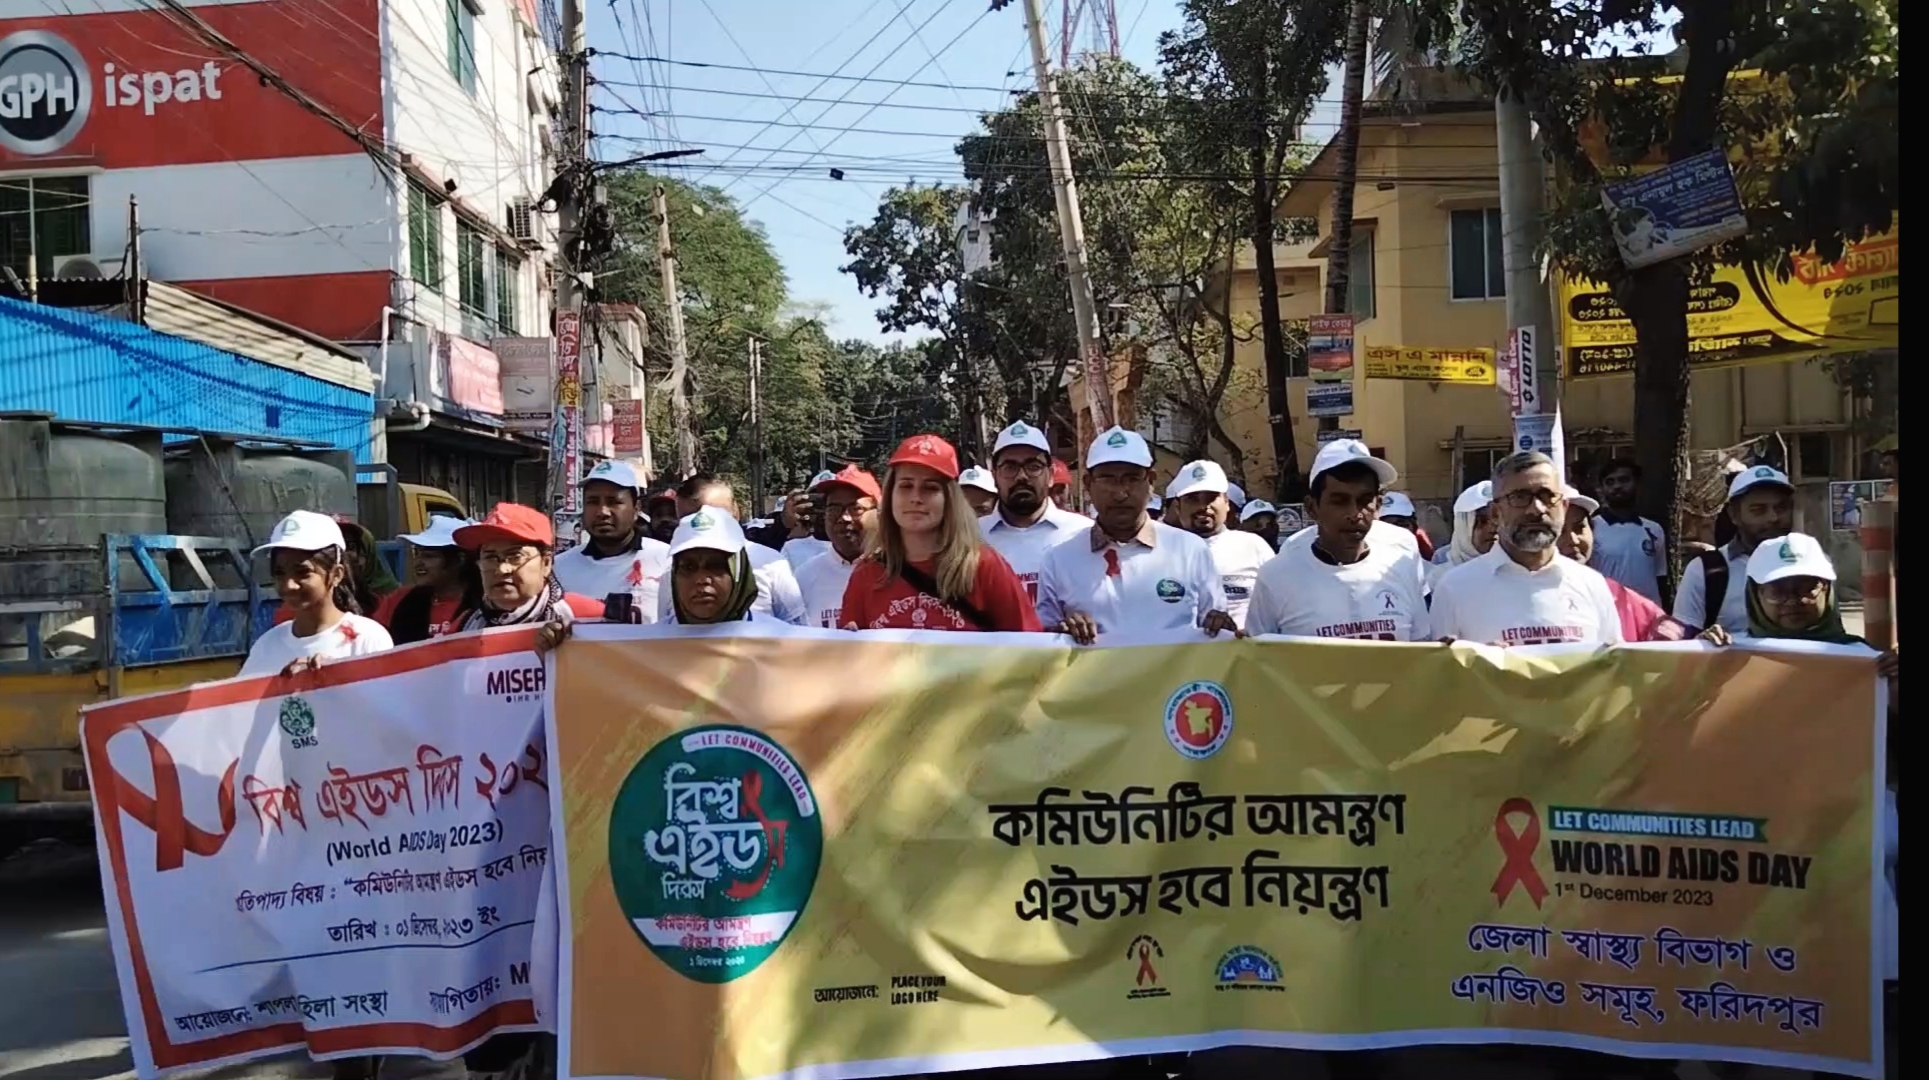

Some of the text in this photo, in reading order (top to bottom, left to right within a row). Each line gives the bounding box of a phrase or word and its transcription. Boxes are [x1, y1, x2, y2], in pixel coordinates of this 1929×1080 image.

[0, 61, 222, 118] GPH ispat
[1367, 349, 1400, 361] এস
[1406, 349, 1423, 361] এ
[1521, 330, 1532, 388] LOTTO
[1316, 625, 1332, 637] LET
[1333, 618, 1397, 637] COMMUNITIES
[1502, 627, 1519, 641] LET
[291, 735, 319, 749] SMS
[701, 733, 807, 800] LET COMMUNITIES LEAD
[316, 761, 415, 831] এইডস
[664, 762, 742, 824] বিশ্ব
[988, 781, 1407, 847] কমিউনিটির আমন্ত্রণ
[326, 819, 504, 867] (World AIDS Day 2023)
[1554, 810, 1755, 839] LET COMMUNITIES LEAD
[235, 889, 287, 913] তিপাদ্য
[291, 882, 325, 906] বিষয়
[482, 855, 514, 880] হবে
[1015, 849, 1389, 927] এইডস হবে নিয়ন্ত্রণ
[1551, 839, 1813, 890] WORLD AIDS DAY
[1580, 883, 1668, 904] December
[1673, 889, 1714, 906] 2023
[326, 918, 377, 942] তারিখ
[1468, 923, 1798, 974] জেলা স্বাস্থ্য বিভাগ ও
[342, 990, 388, 1016] সংস্থা
[891, 975, 947, 988] PLACE YOUR
[891, 990, 939, 1006] LOGO HERE
[1451, 965, 1826, 1036] এনজিও সমূহ, ফরিদপুর
